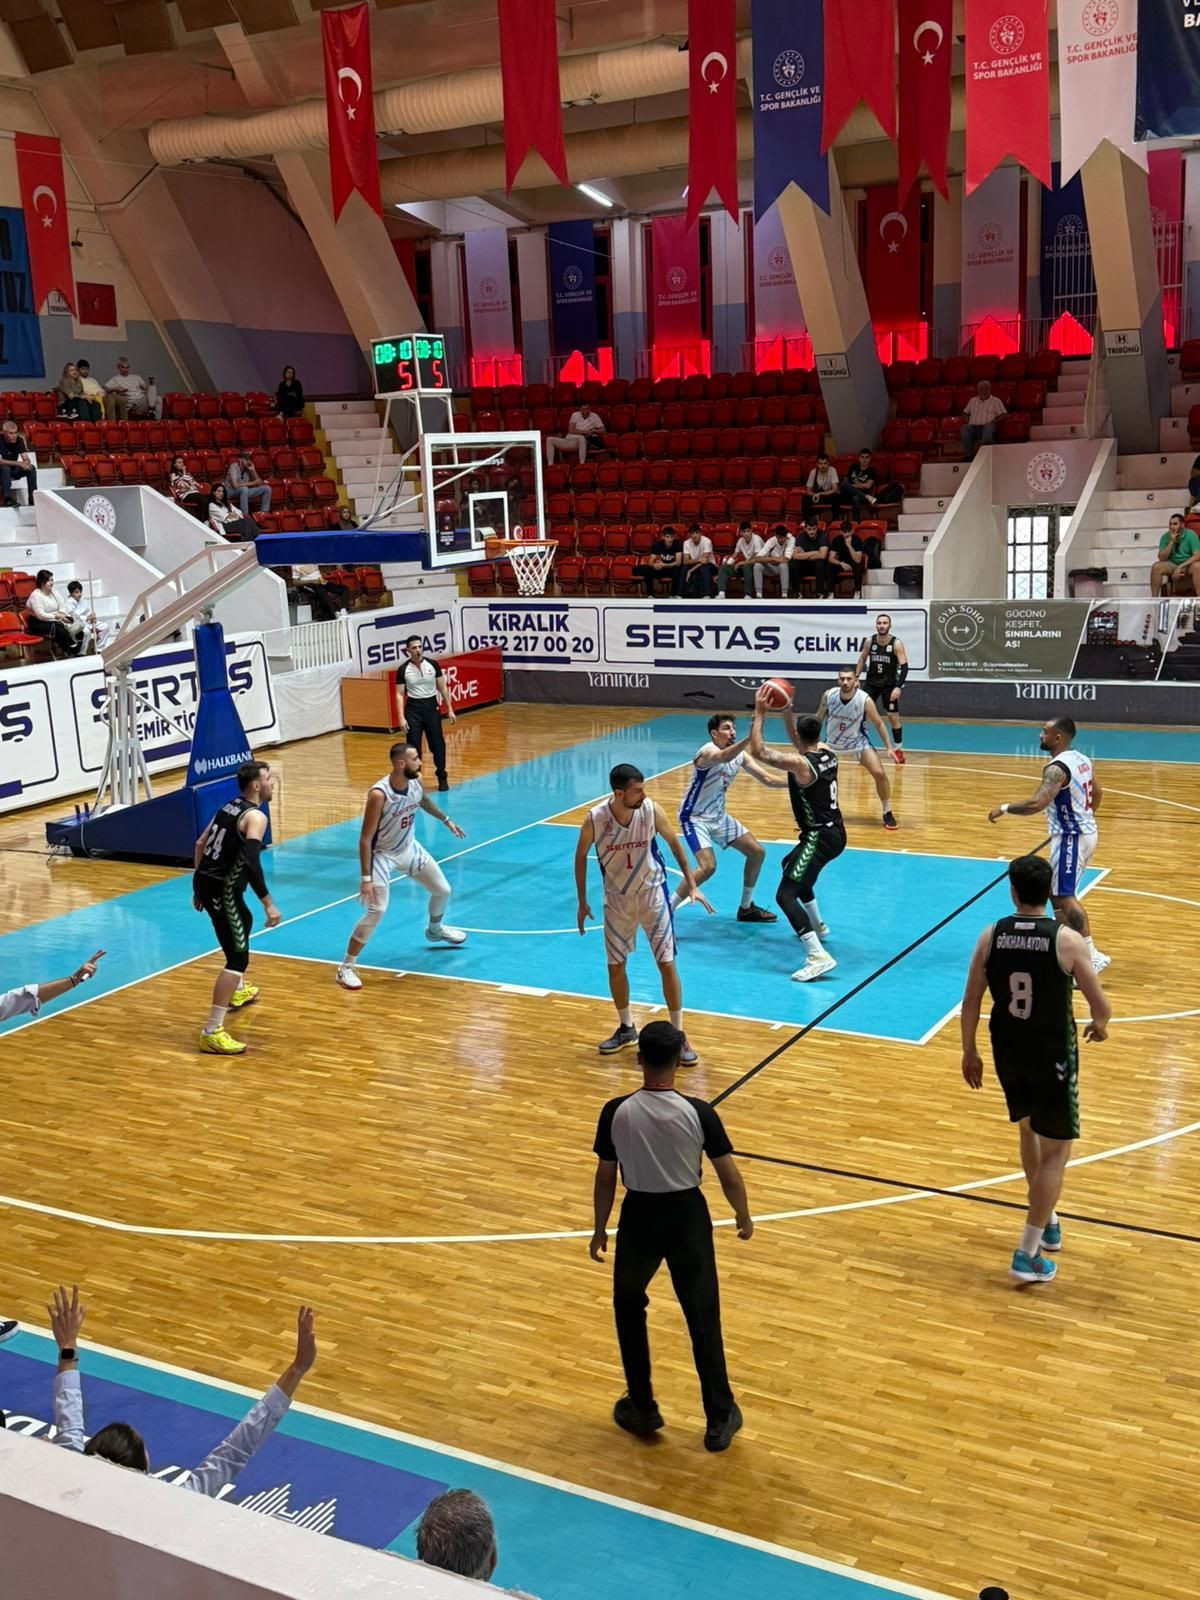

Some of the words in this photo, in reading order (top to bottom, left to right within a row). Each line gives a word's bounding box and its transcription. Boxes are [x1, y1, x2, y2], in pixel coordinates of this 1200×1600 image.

[1066, 44, 1082, 53] T.C.
[1084, 36, 1123, 51] GENÇLİK
[1125, 33, 1137, 42] VE
[973, 61, 989, 70] T.C.
[991, 54, 1028, 68] GENÇLİK
[1030, 52, 1042, 61] VE
[1066, 54, 1089, 64] SPOR
[973, 71, 996, 80] SPOR
[997, 62, 1042, 77] BAKANLIĞI
[775, 88, 808, 99] GENÇLİK
[810, 86, 820, 94] VE
[760, 103, 779, 111] SPOR
[781, 95, 821, 109] BAKANLIĞI
[1118, 335, 1126, 343] H
[1107, 344, 1139, 354] TRİBÜNÜ
[398, 361, 412, 389] 5
[432, 360, 443, 387] 5
[938, 606, 957, 624] GYM
[960, 605, 984, 624] SOHO
[1005, 609, 1047, 618] GÜCÜNÜ
[626, 624, 780, 652] SERTAŞ
[794, 633, 842, 653] ÇELİK
[1005, 630, 1062, 638] SINIRLARINI
[367, 632, 446, 666] SERAŞ
[468, 635, 508, 652] 0532
[513, 635, 539, 652] 217
[544, 636, 567, 653] 00
[572, 636, 594, 653] 20
[1004, 640, 1021, 648] AŞ!
[877, 664, 883, 673] 5
[136, 715, 171, 741] EMİR
[207, 751, 253, 770] HALKBANK
[830, 780, 838, 809] 9
[401, 814, 415, 829] 62
[203, 824, 227, 861] 24
[626, 853, 633, 869] 1
[996, 932, 1026, 950] GÖKHAN
[1026, 936, 1050, 952] AYDIN
[1008, 971, 1033, 1020] 8
